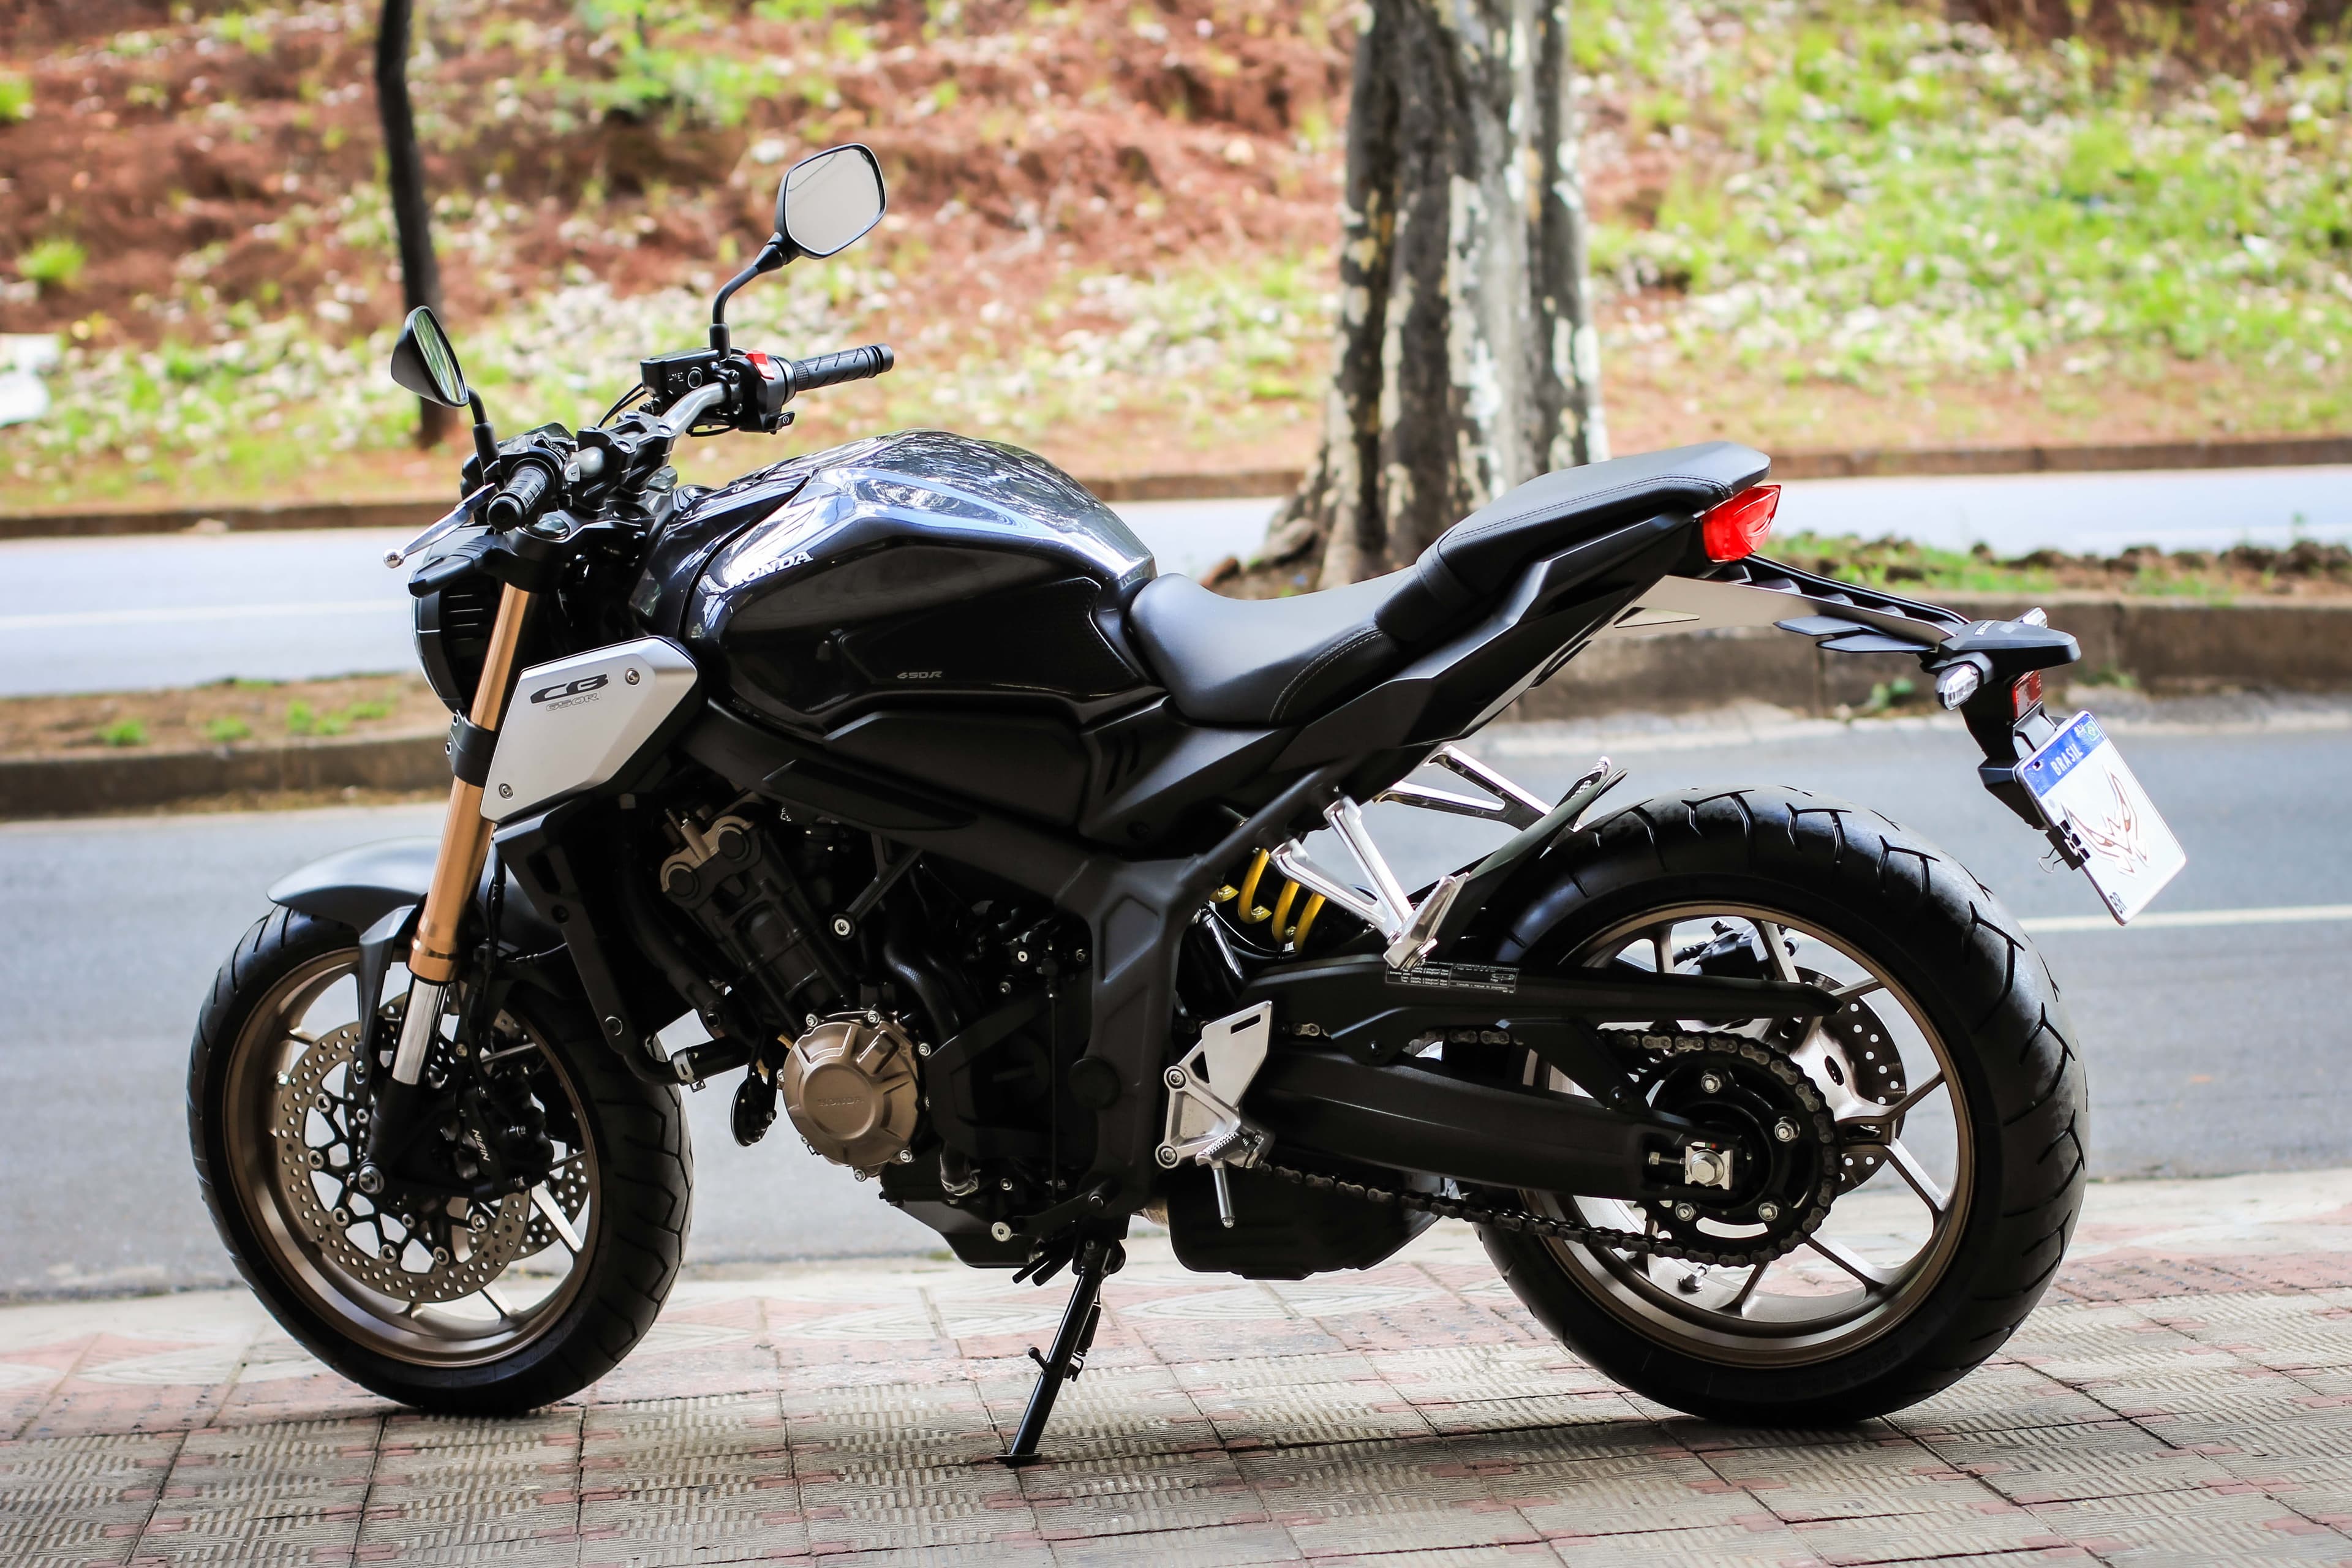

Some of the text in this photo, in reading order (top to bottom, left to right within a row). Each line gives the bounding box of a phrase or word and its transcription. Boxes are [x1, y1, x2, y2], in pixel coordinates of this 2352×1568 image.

[729, 551, 814, 588] ONDA
[530, 674, 609, 704] CB
[897, 671, 943, 679] 650R
[546, 692, 600, 712] 650R
[2050, 743, 2084, 777] BRASIL
